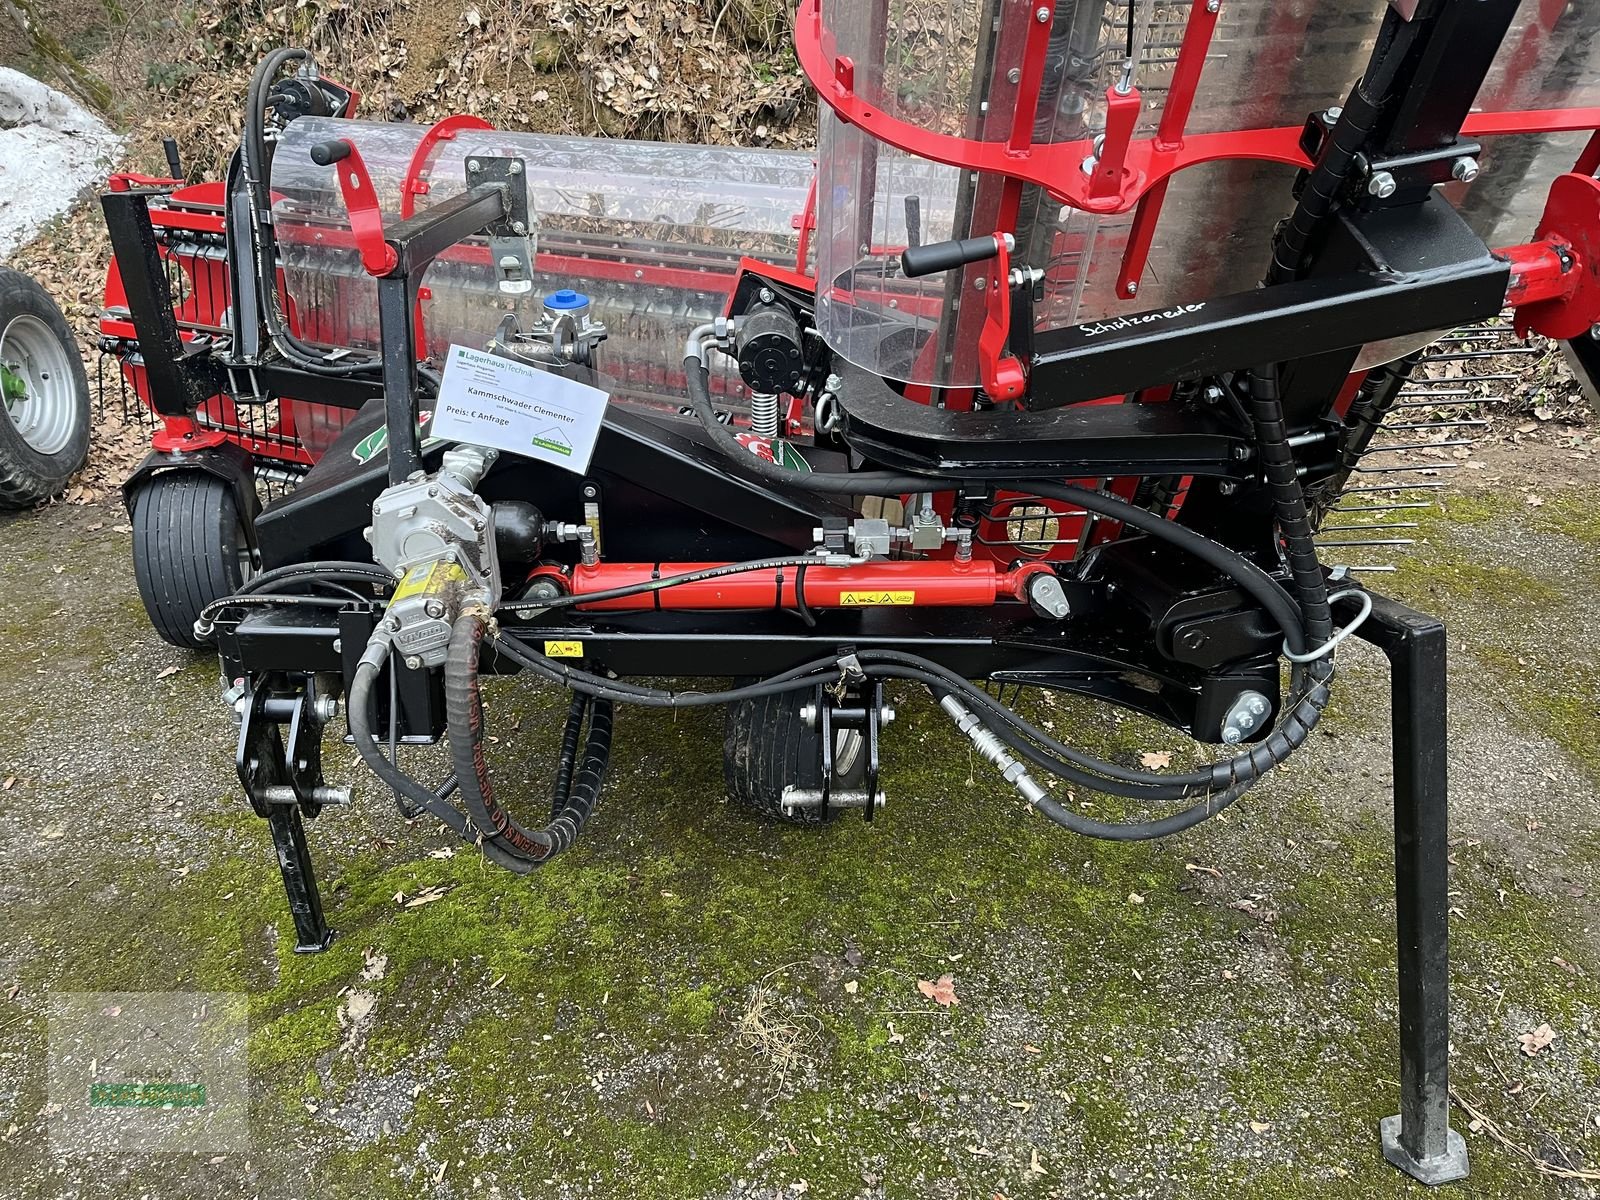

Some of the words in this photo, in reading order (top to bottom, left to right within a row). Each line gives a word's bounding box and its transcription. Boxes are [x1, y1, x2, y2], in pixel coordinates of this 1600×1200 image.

[465, 351, 505, 369] Lagerhaus
[508, 363, 534, 378] Technik
[446, 405, 469, 417] Preis:
[470, 410, 477, 418] €
[477, 412, 510, 426] Anfrage
[467, 386, 533, 411] Kammschwader
[533, 405, 575, 424] Clementer
